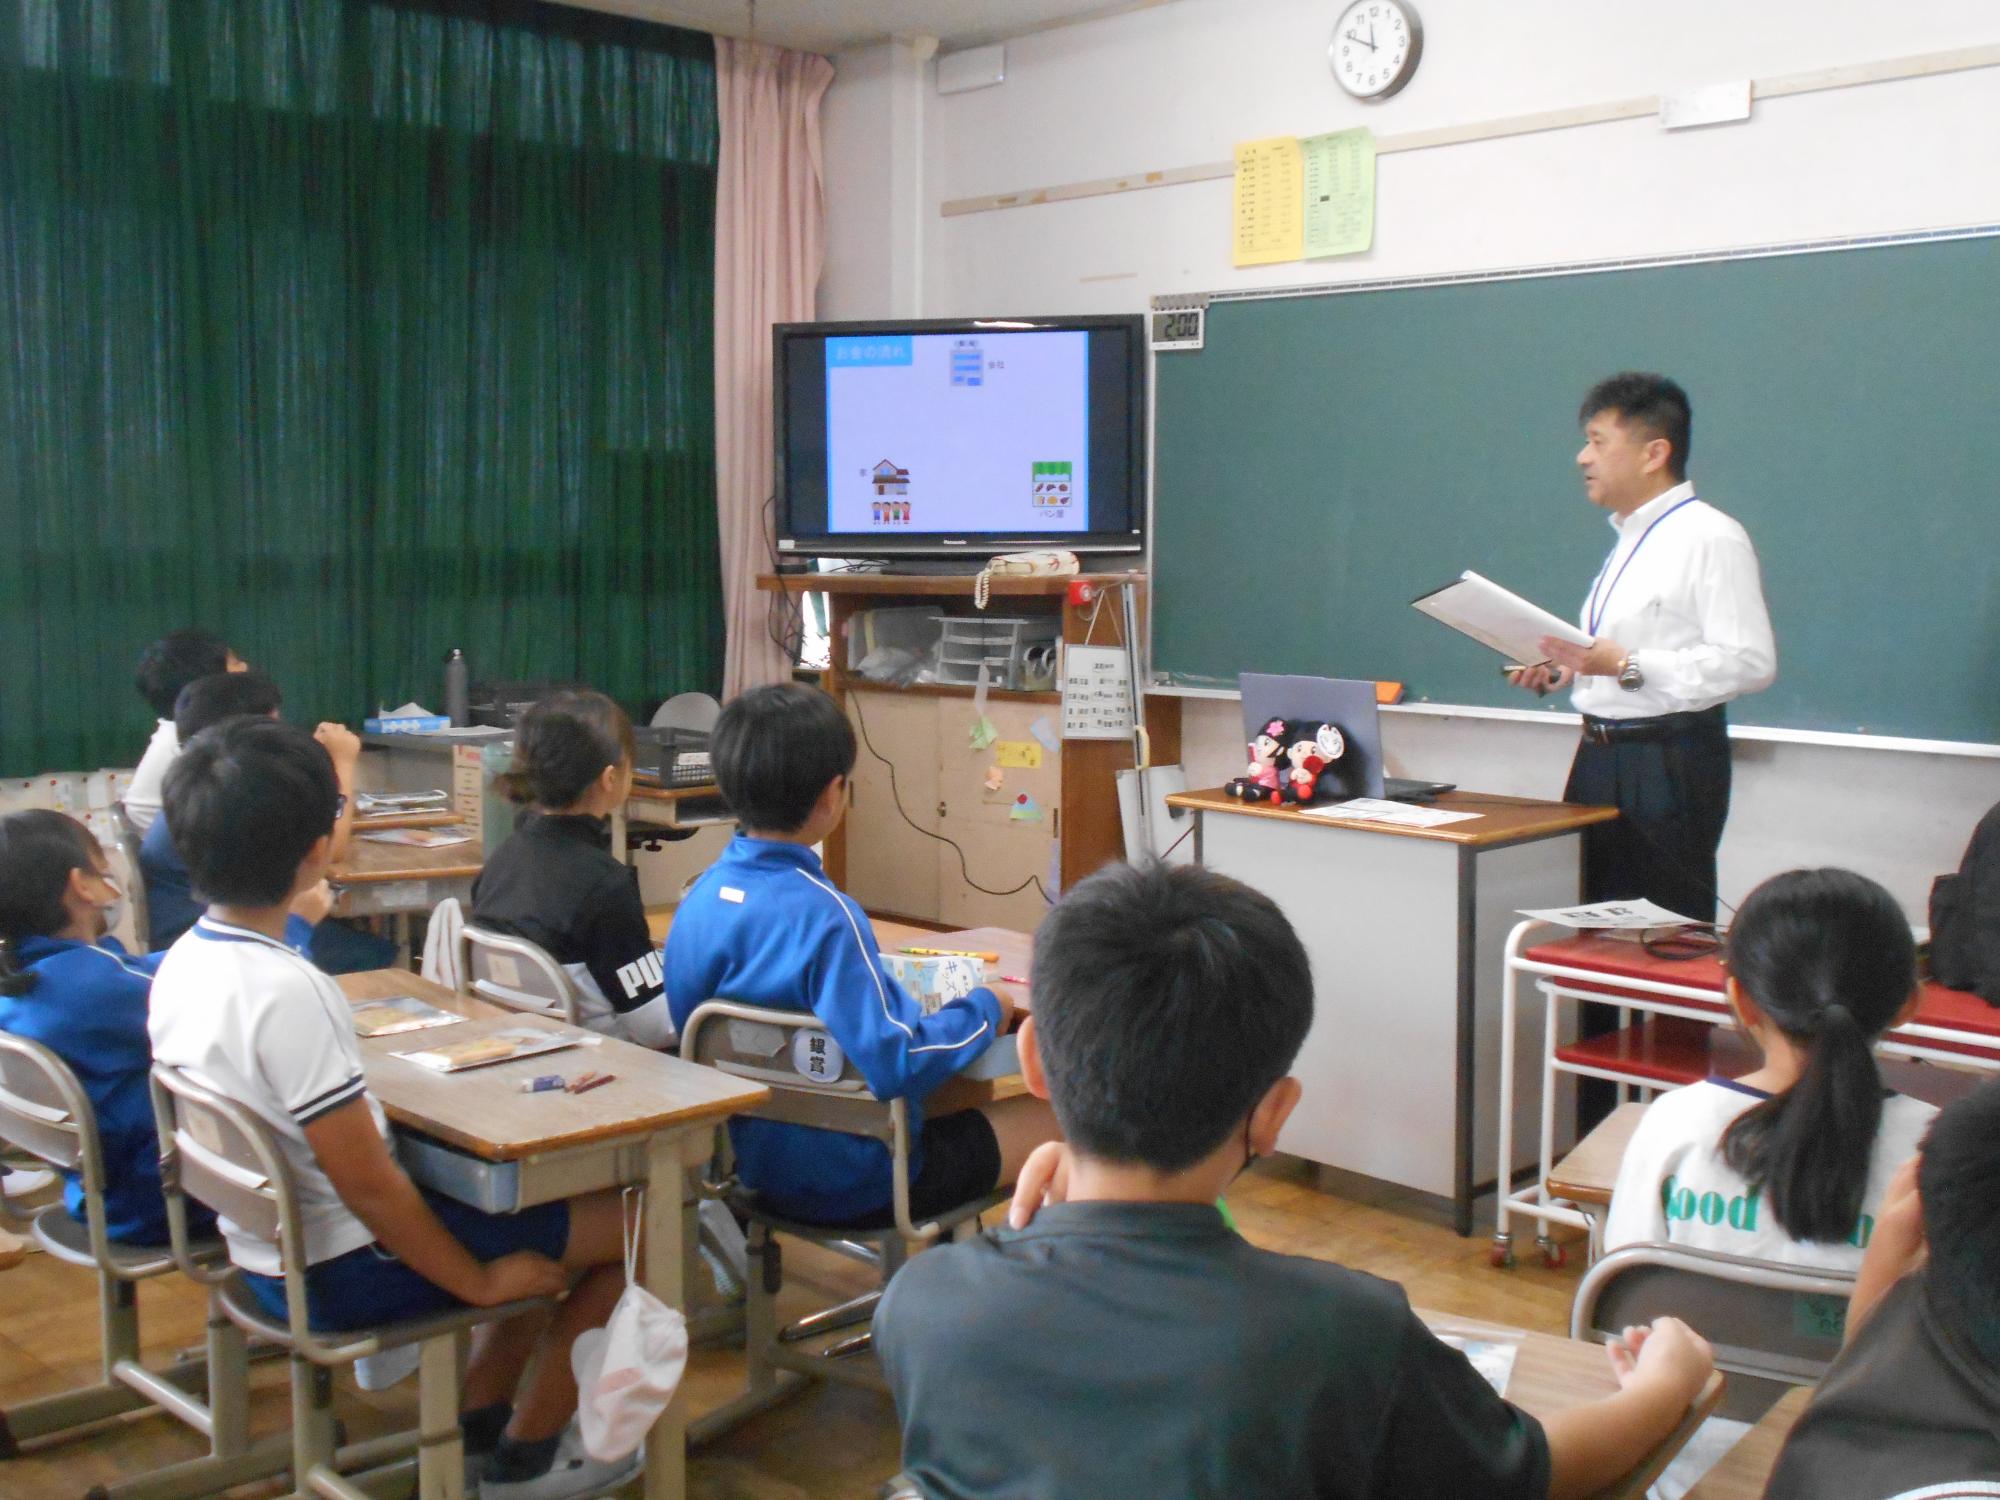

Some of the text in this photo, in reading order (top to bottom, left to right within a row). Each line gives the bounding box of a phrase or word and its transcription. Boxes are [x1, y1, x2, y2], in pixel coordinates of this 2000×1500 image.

[1369, 6, 1380, 17] 12
[1356, 14, 1365, 24] 11
[1394, 19, 1401, 30] 2
[1398, 36, 1405, 47] 3
[1343, 45, 1350, 57] 9
[1393, 54, 1400, 64] 4
[1346, 61, 1353, 72] 8
[1356, 72, 1363, 84] 7
[1382, 68, 1390, 80] 5
[1368, 74, 1376, 86] 6
[616, 949, 664, 1000] PU
